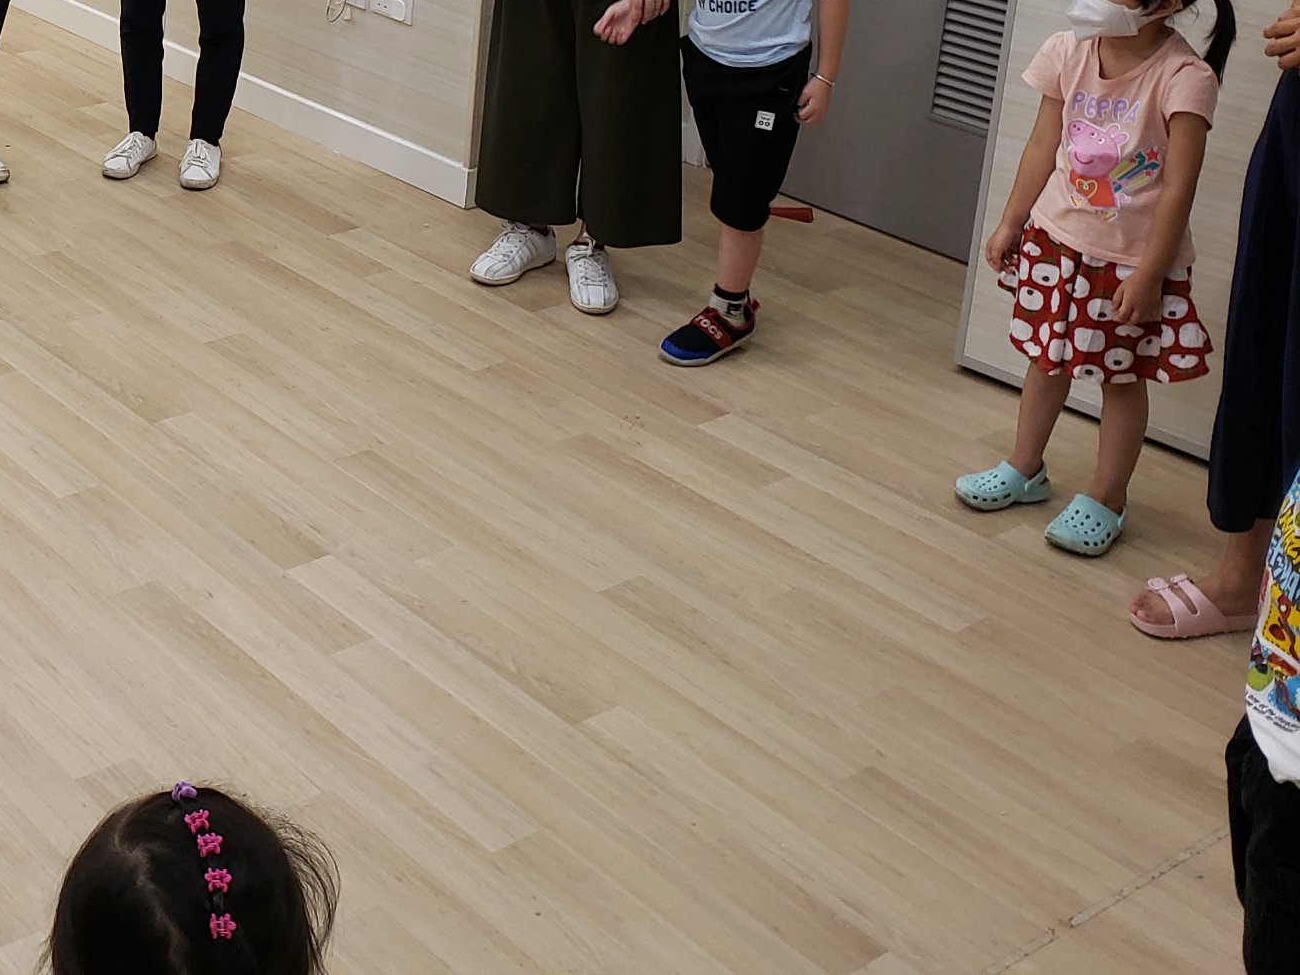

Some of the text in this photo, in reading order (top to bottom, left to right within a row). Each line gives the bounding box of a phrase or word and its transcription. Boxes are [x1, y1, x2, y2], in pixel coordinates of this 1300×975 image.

[708, 0, 759, 14] CHOICE
[1070, 90, 1140, 123] PEPPA
[694, 315, 723, 340] rocs
